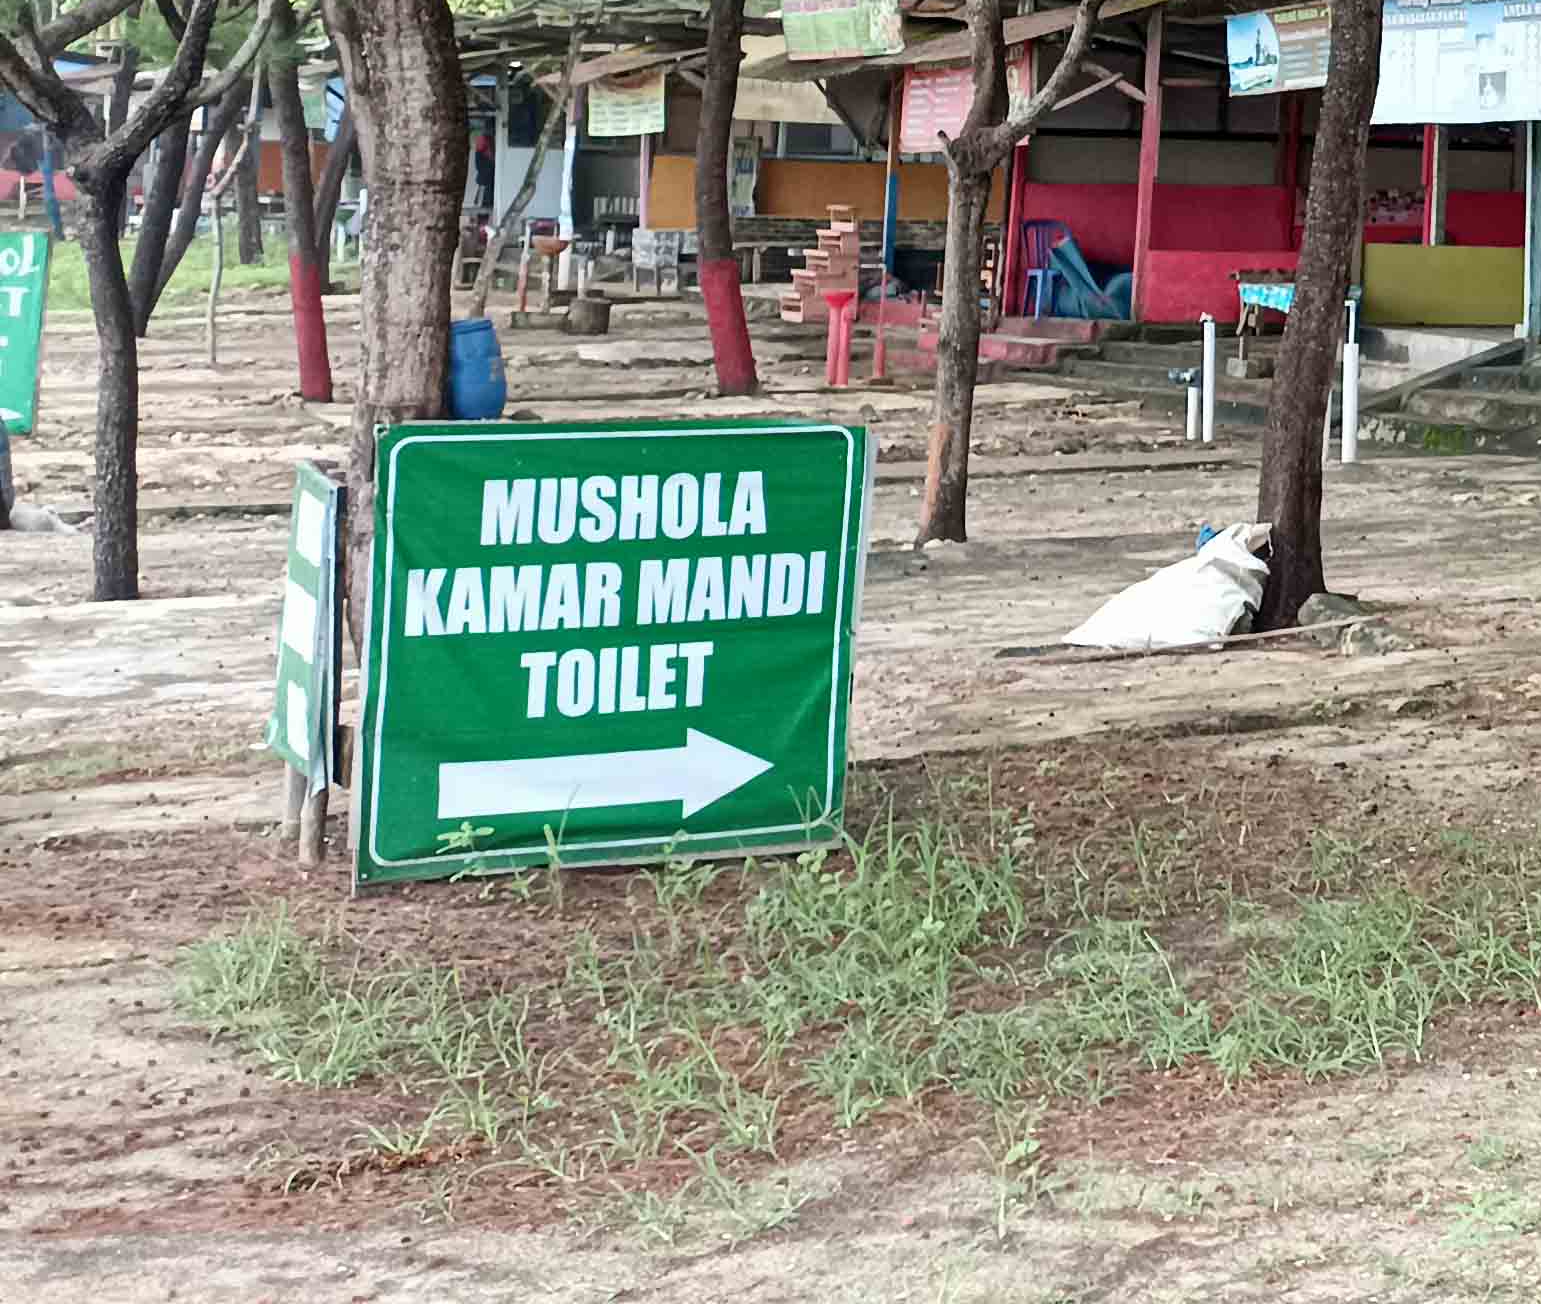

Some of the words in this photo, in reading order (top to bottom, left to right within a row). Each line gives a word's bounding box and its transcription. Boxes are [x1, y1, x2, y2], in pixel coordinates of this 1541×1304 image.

[480, 470, 767, 546] MUSHOLA
[403, 562, 624, 637] KAMAR
[636, 550, 827, 626] MANDI
[519, 641, 714, 719] TOILET
